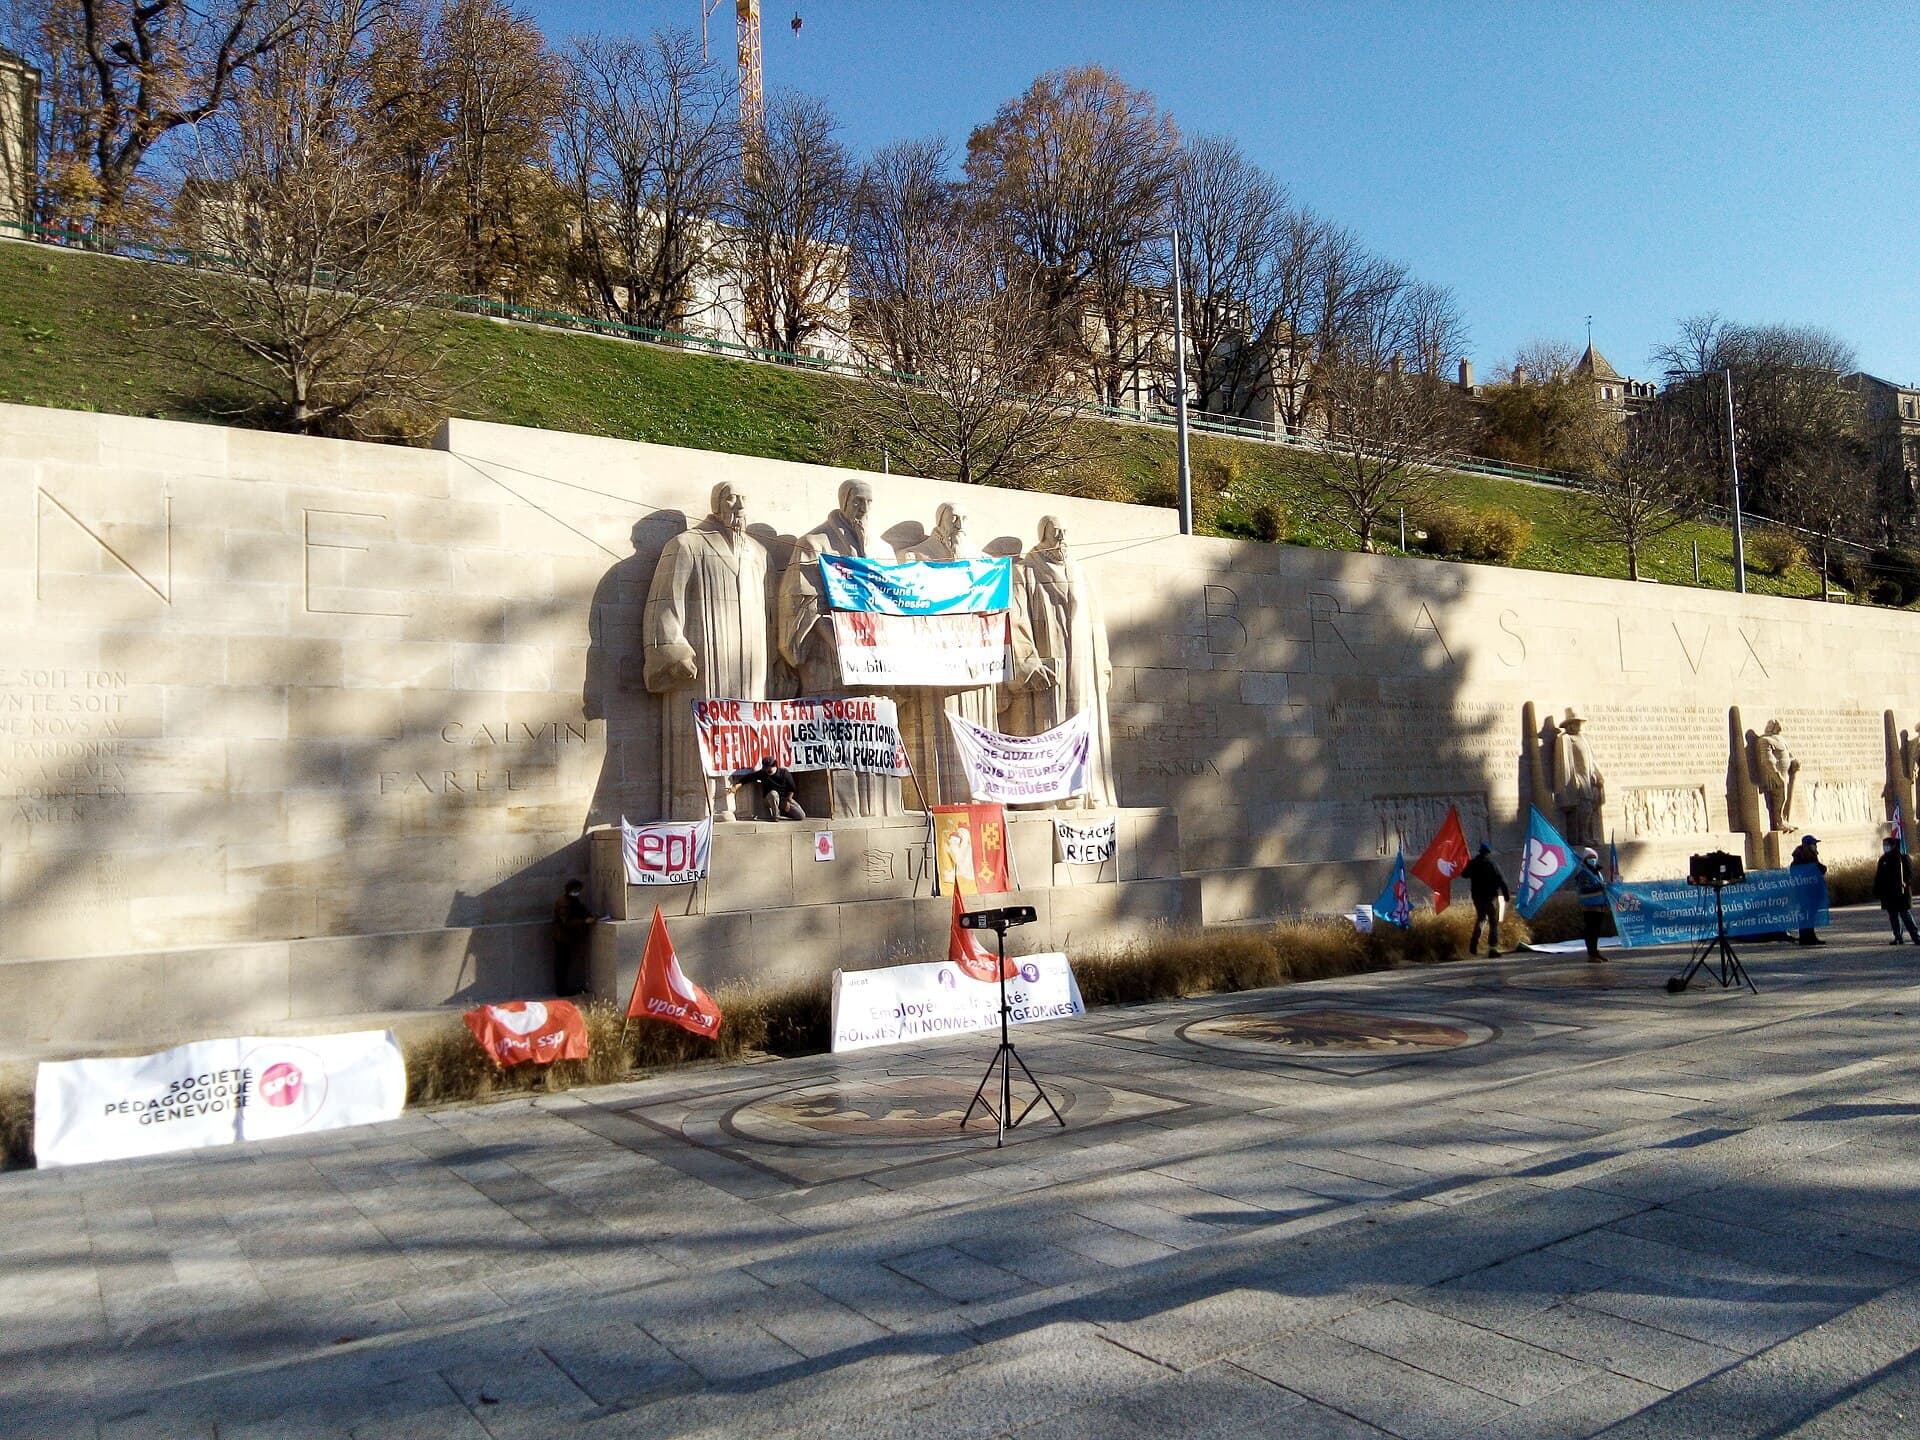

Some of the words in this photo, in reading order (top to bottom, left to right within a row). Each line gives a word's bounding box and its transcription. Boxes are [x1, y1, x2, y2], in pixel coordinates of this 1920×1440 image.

[697, 700, 743, 722] POUR
[822, 698, 877, 722] SOCIAL
[440, 721, 588, 745] CALVIN
[378, 769, 522, 795] FAREL
[642, 874, 655, 883] EN
[1709, 899, 1743, 914] dpuis
[1007, 1001, 1080, 1023] IGEONNES!
